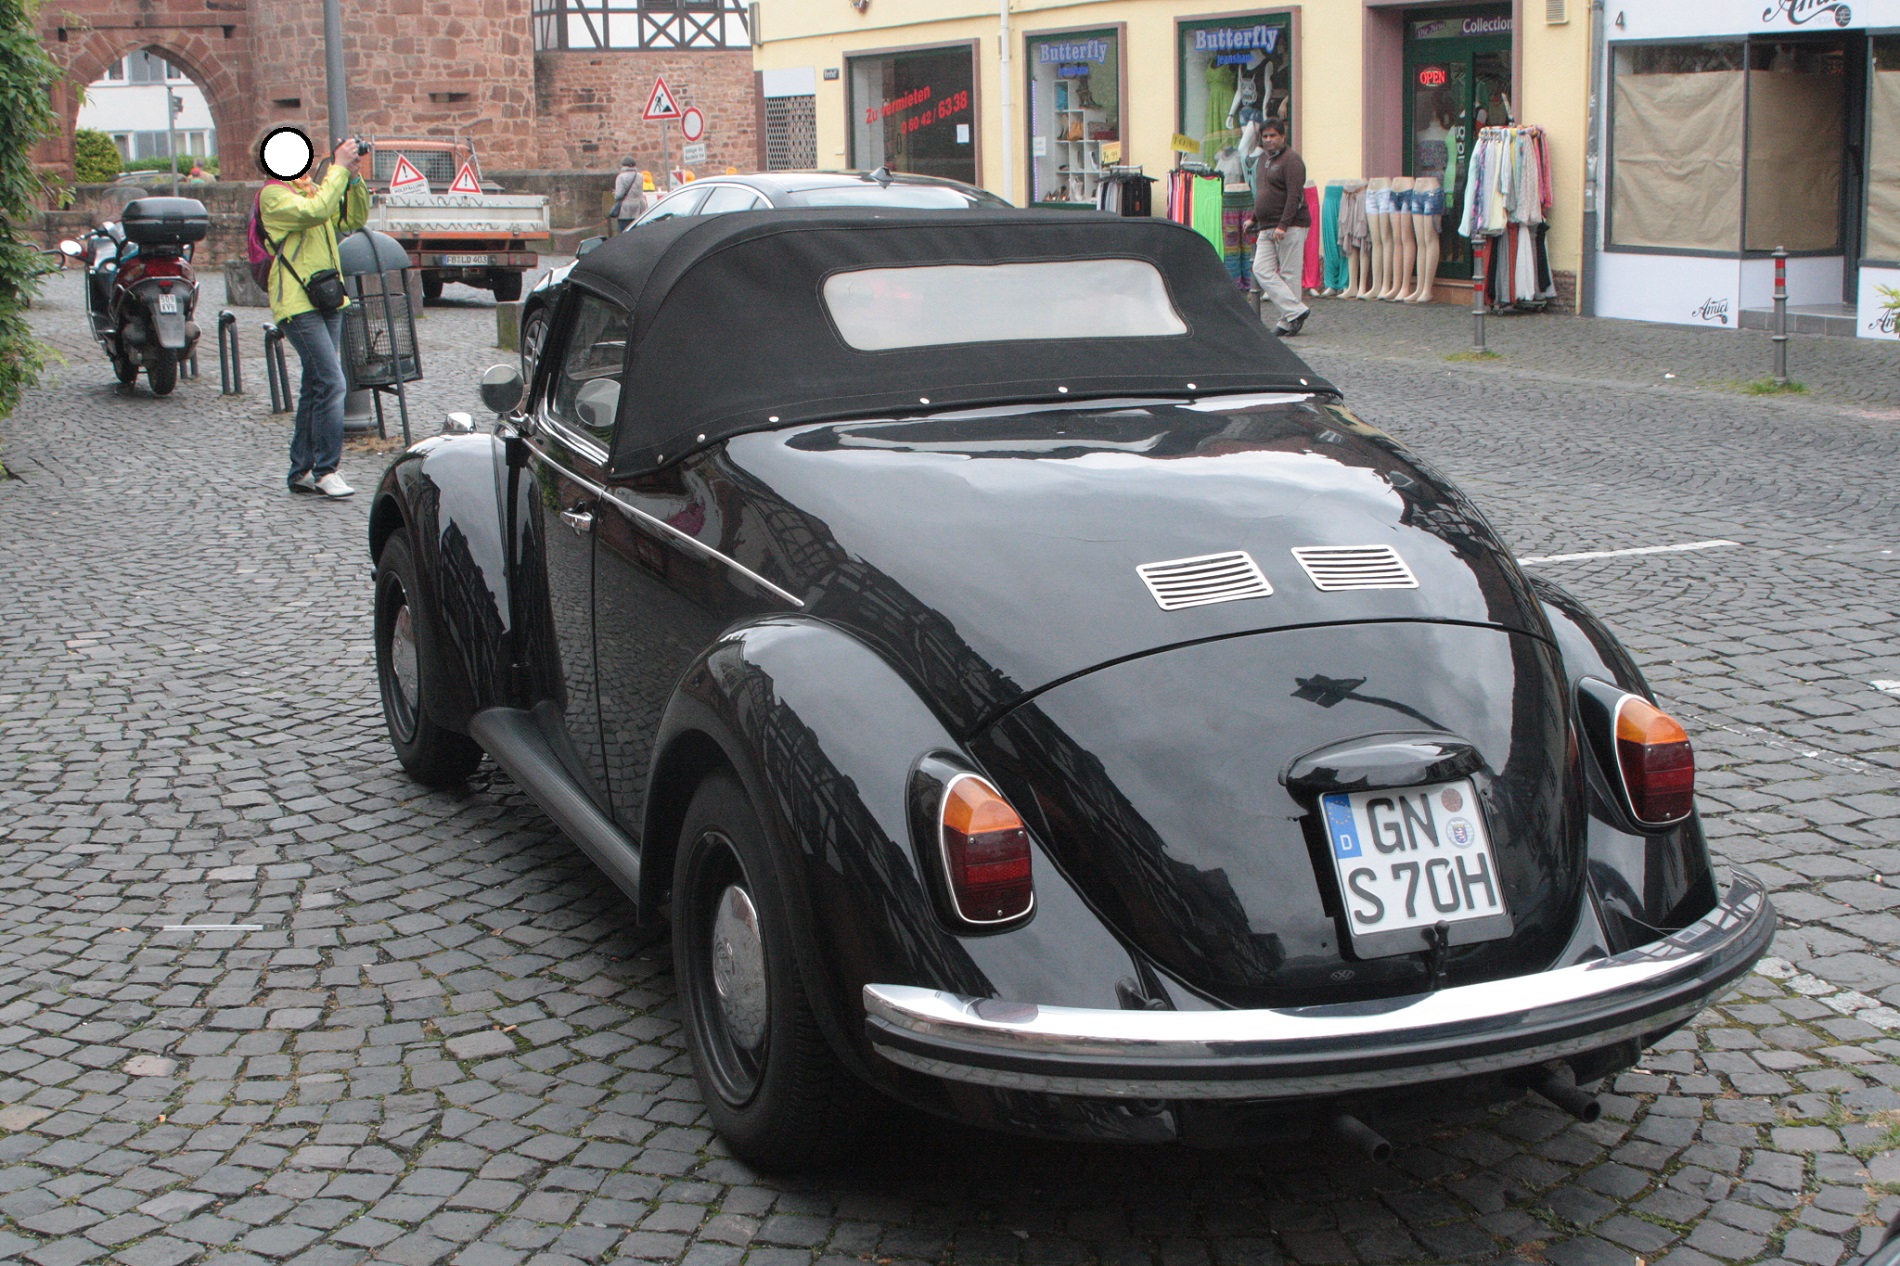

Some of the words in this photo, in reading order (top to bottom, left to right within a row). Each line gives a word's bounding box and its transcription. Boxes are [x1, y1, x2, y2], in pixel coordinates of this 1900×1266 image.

[1462, 16, 1513, 33] Collection
[1615, 10, 1625, 31] 4
[1040, 38, 1109, 65] Butterfly
[1194, 25, 1279, 54] Butterfly
[1420, 70, 1447, 86] OPEN
[865, 107, 878, 125] Zu
[881, 85, 931, 118] vermieten
[1366, 793, 1440, 854] GN
[1339, 834, 1353, 851] D
